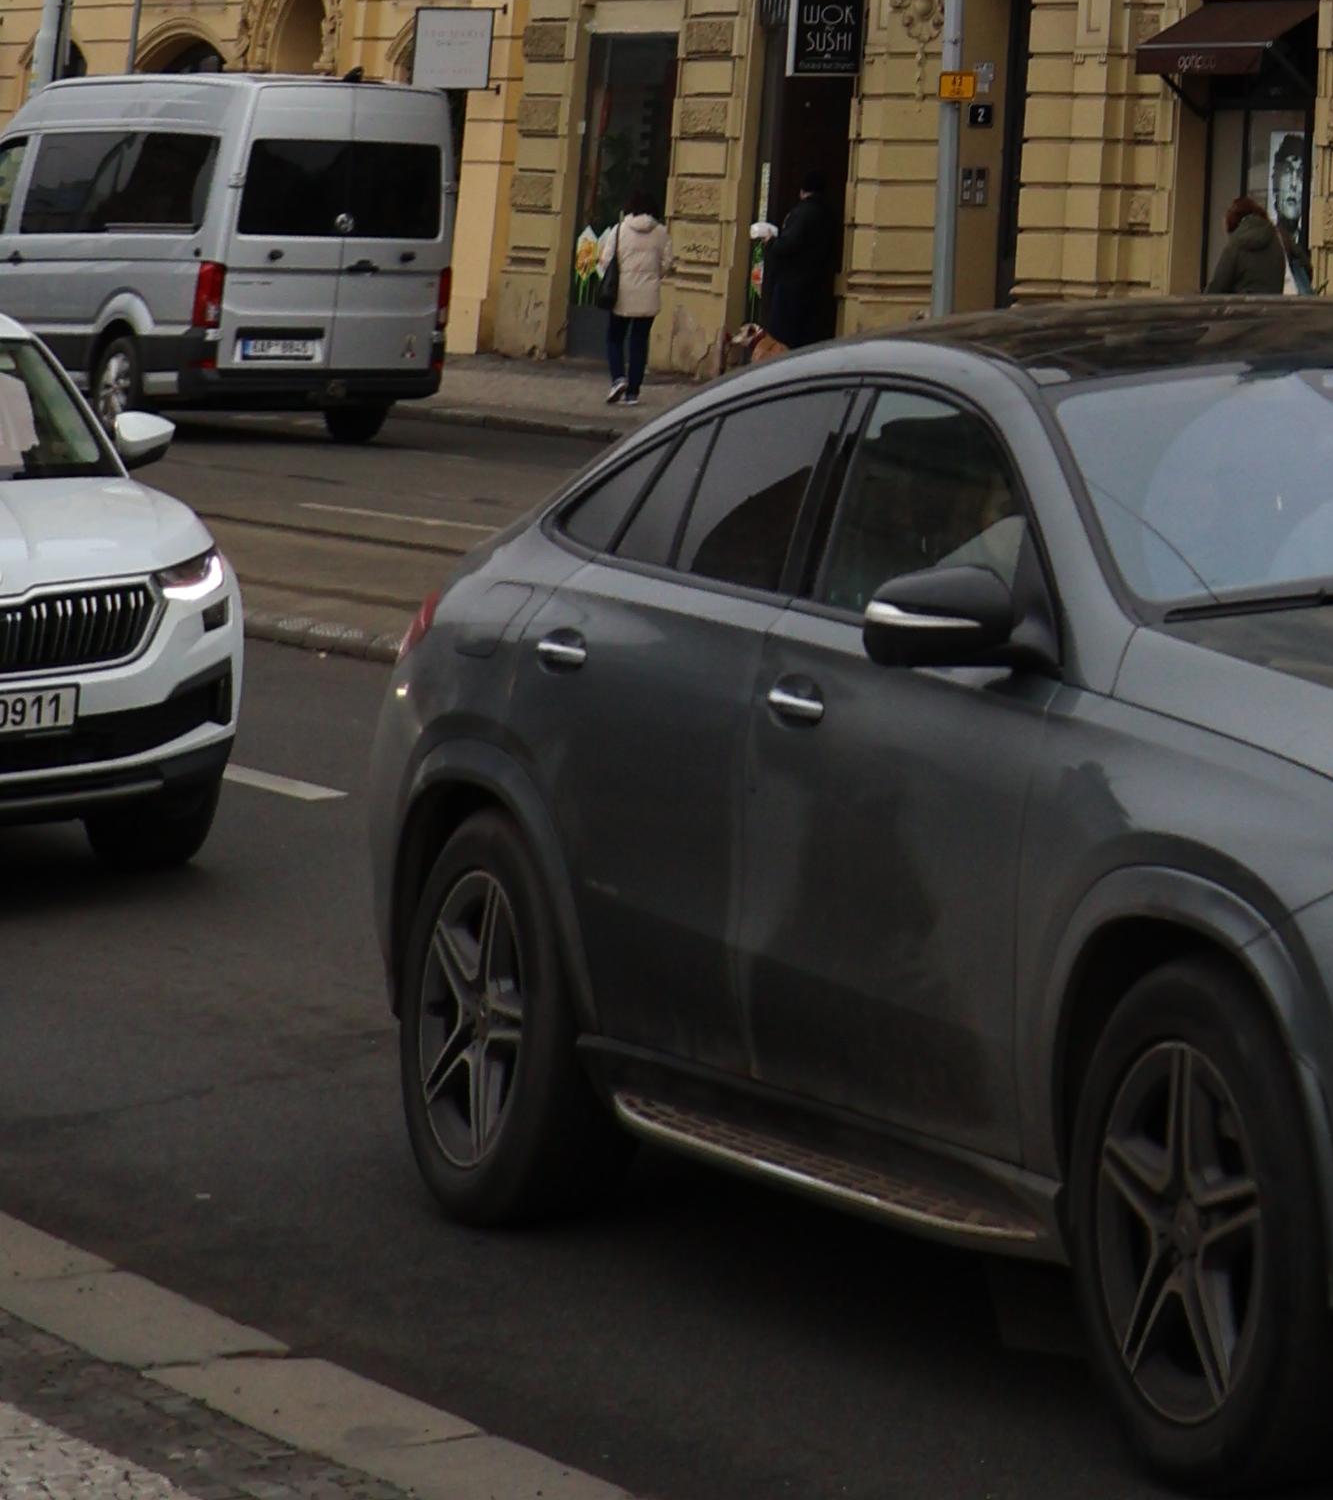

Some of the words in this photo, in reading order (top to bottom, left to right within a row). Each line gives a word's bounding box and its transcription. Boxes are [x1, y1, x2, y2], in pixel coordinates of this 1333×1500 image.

[803, 4, 856, 25] WOK
[805, 31, 852, 52] SUSHI
[977, 108, 985, 123] 2
